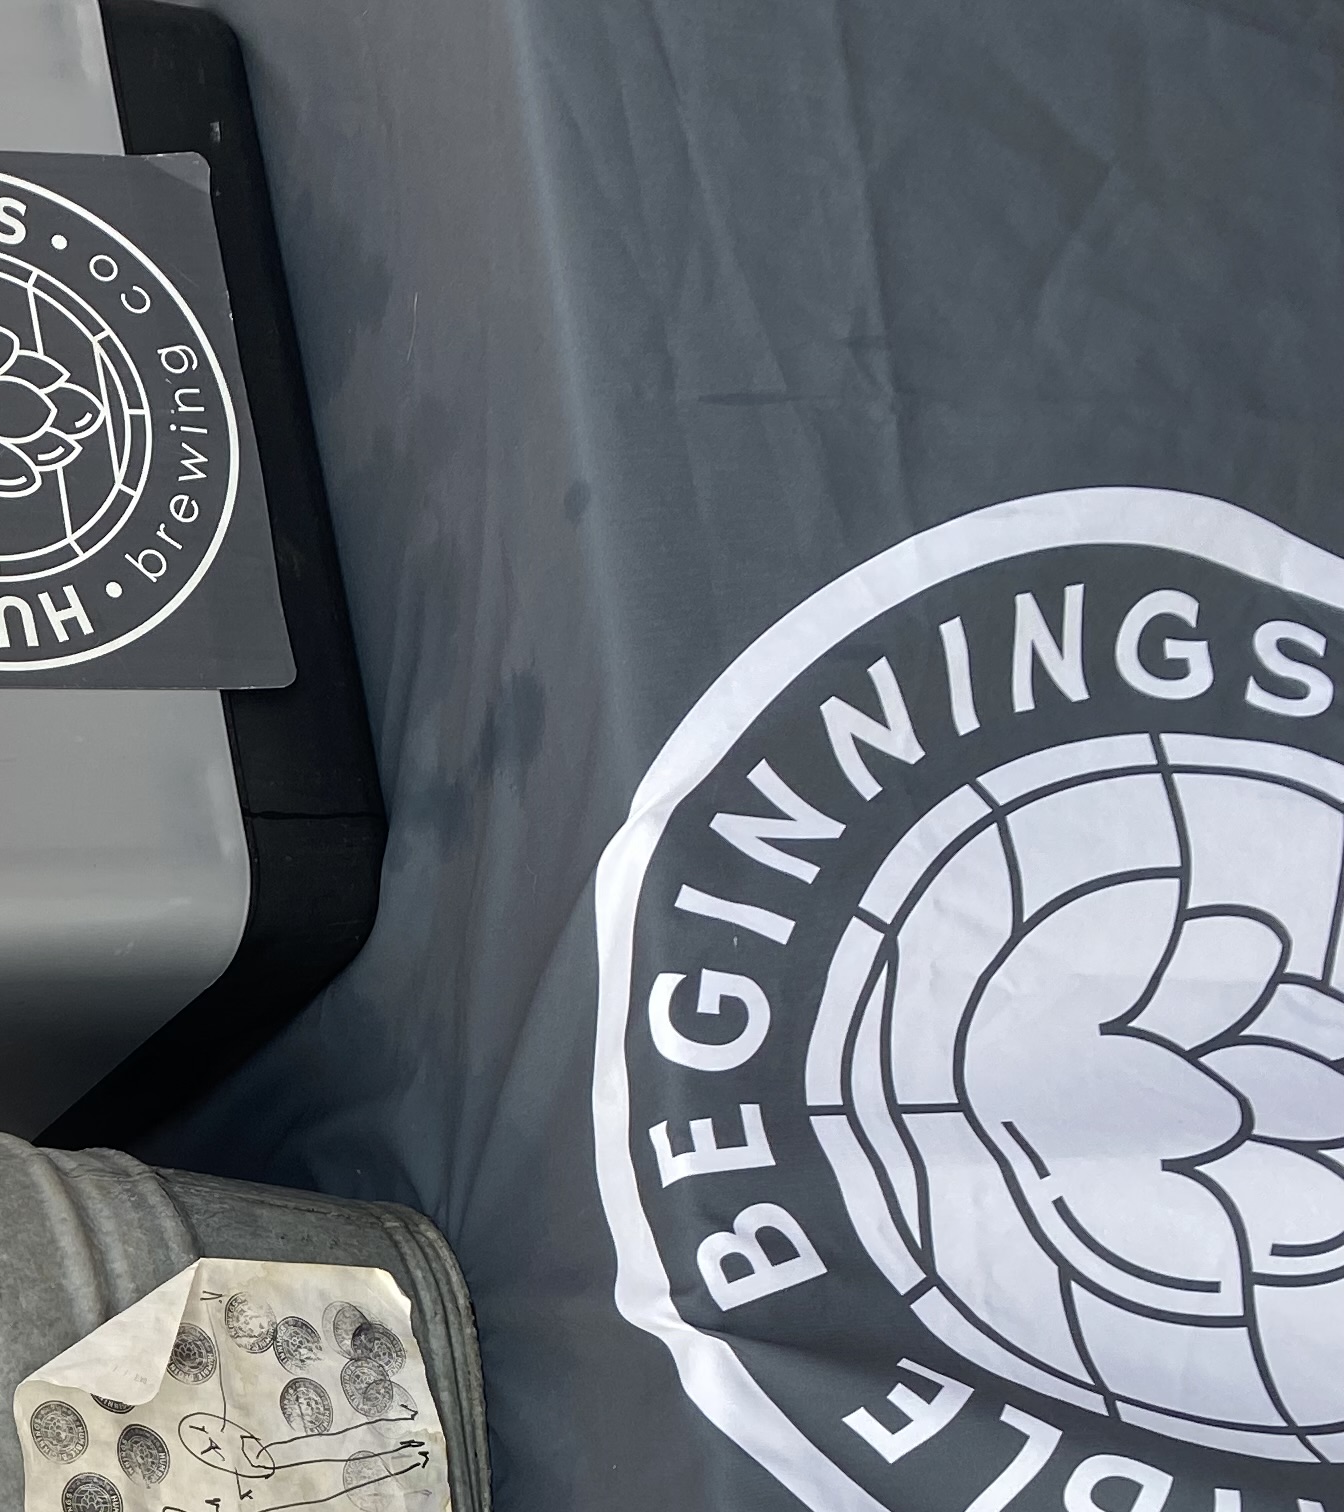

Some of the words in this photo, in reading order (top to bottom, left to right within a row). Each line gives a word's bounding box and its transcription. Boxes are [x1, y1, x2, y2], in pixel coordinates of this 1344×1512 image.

[88, 254, 151, 314] co
[125, 344, 209, 583] brewing
[646, 582, 1337, 1311] BEGINNINGS
